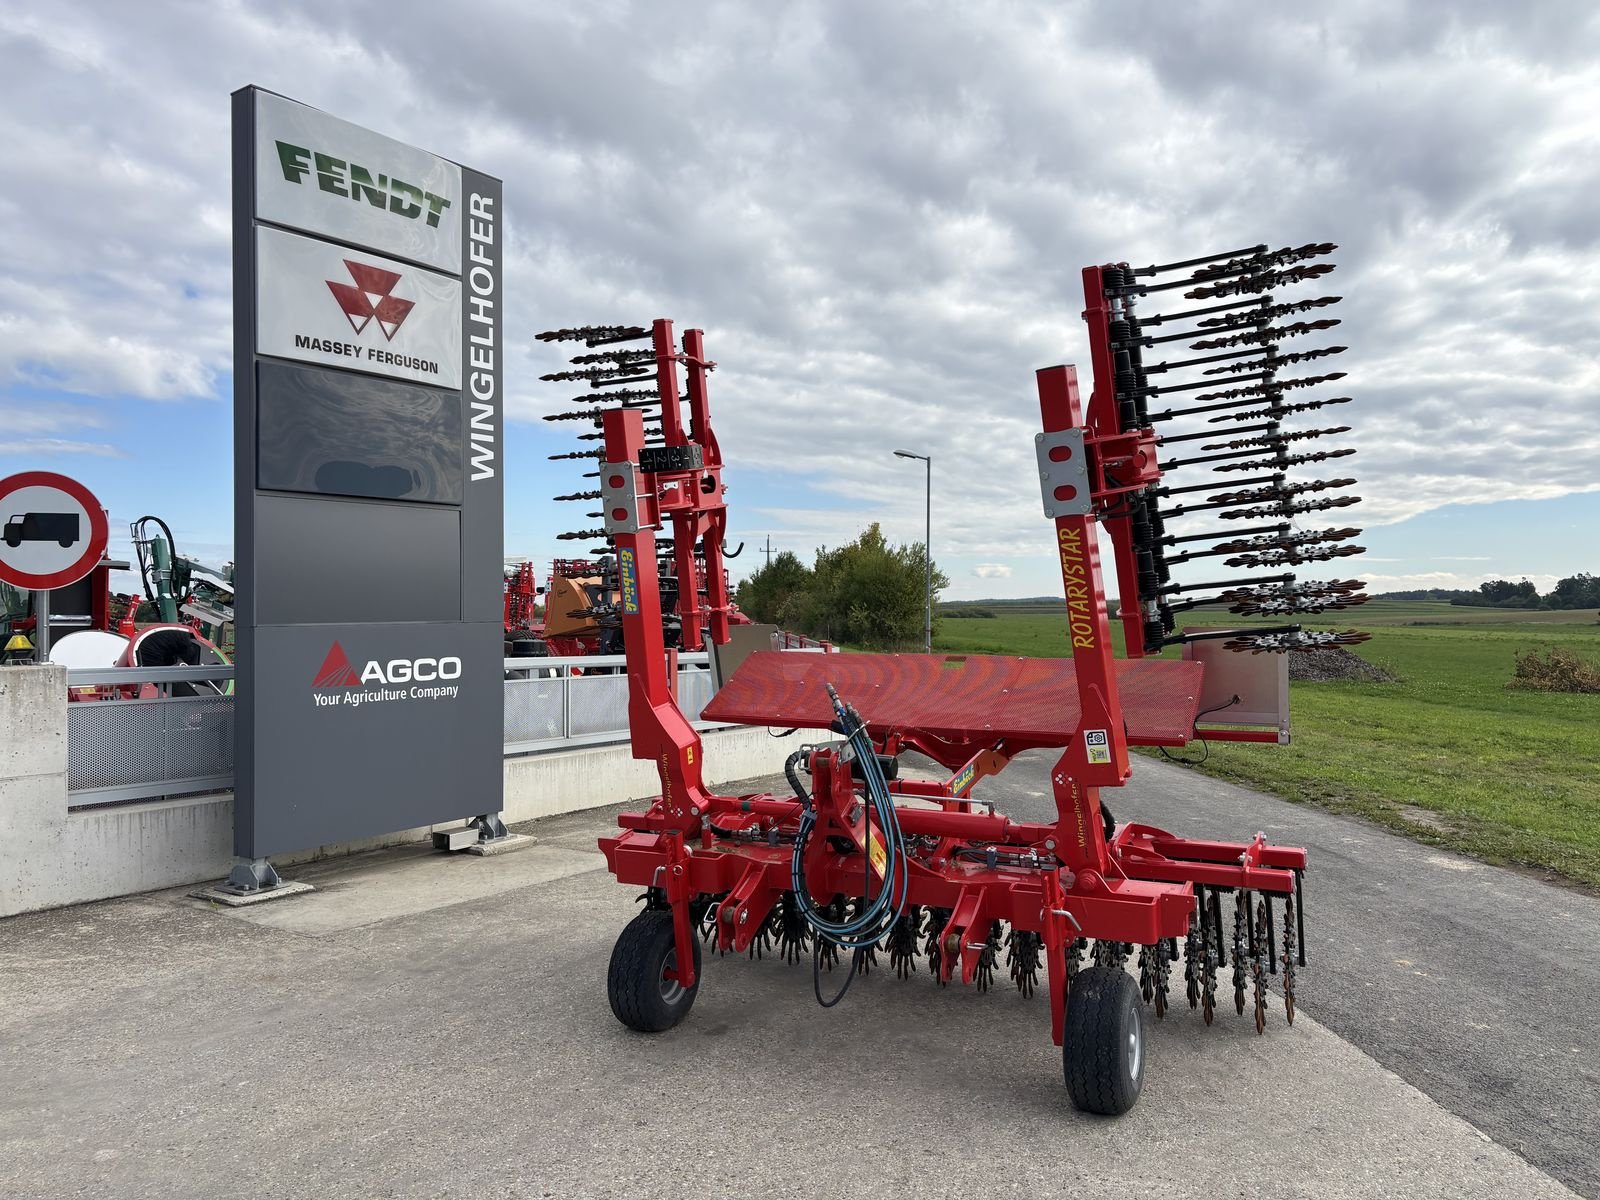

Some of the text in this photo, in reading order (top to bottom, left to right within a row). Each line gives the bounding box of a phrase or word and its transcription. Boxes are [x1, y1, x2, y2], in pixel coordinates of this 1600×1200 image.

[275, 140, 451, 229] FENDT
[295, 334, 439, 374] MASSEY FERGUSON
[469, 192, 495, 482] WINGELHOFER
[620, 548, 638, 613] Einböck
[1059, 527, 1094, 649] ROTARYSTAR
[313, 685, 459, 707] Your Agriculture Company
[361, 656, 462, 685] AGCO
